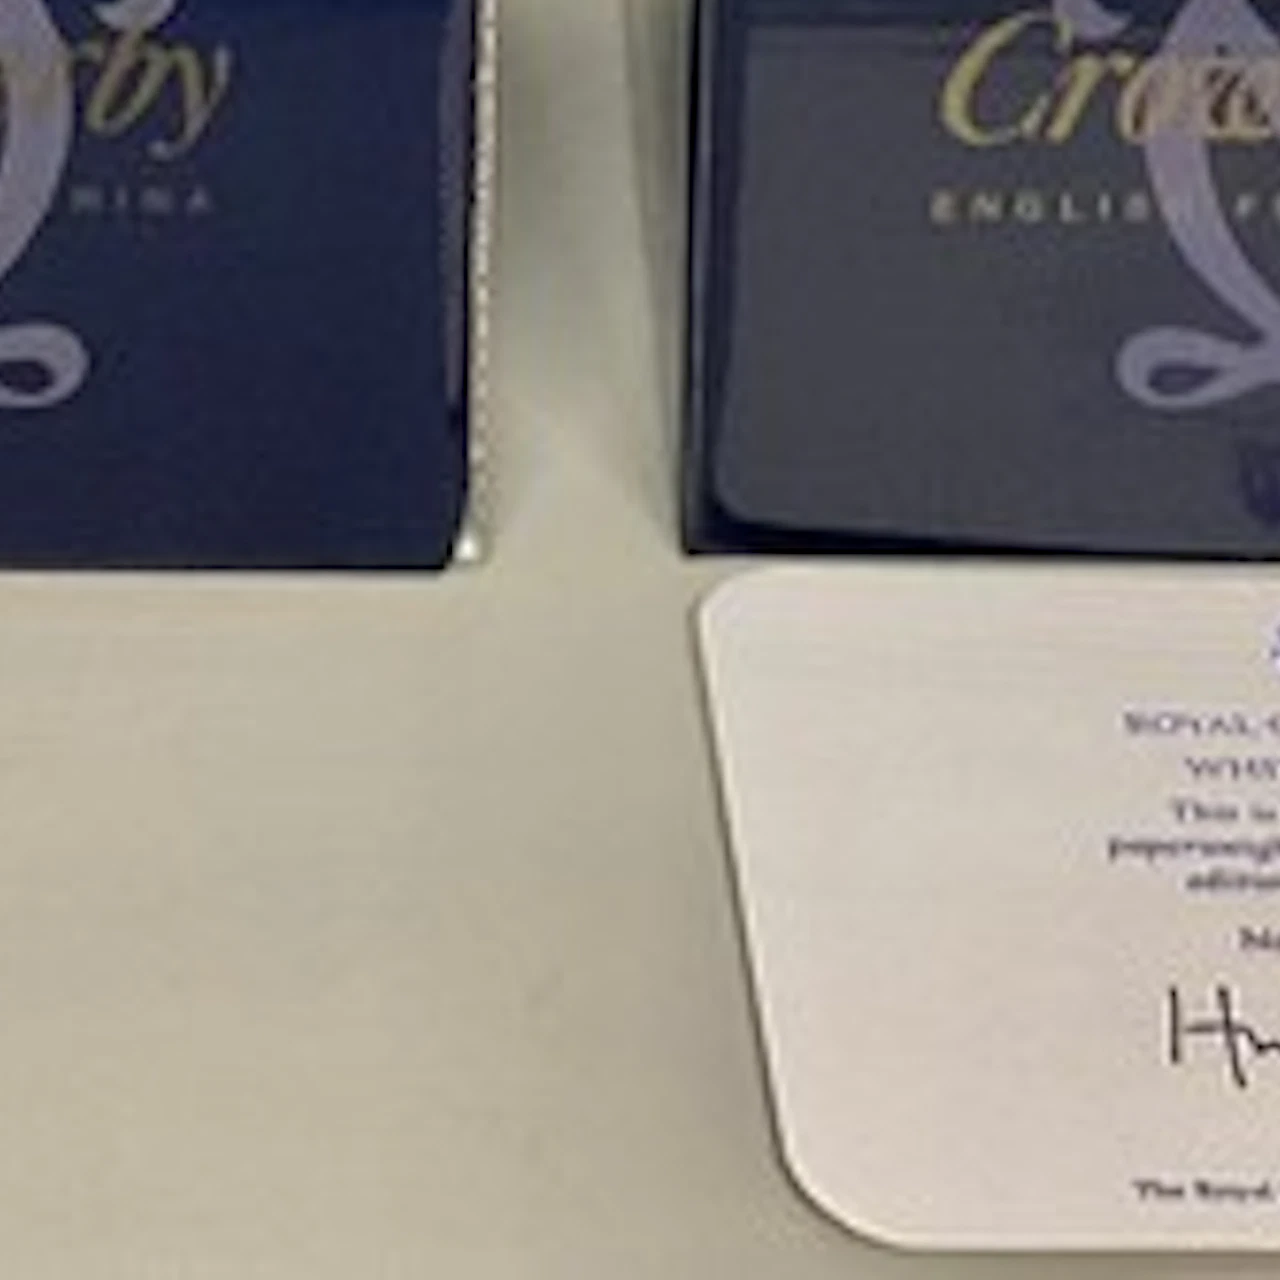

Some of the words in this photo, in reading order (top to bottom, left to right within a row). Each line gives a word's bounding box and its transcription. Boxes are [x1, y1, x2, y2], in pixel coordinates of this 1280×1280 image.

[68, 184, 216, 212] HINA
[929, 191, 1152, 224] ENGLIS
[1123, 711, 1258, 736] ROYAL
[1172, 799, 1239, 822] This
[1250, 805, 1277, 822] is
[1132, 1178, 1185, 1200] The
[1193, 1178, 1270, 1203] Royal
